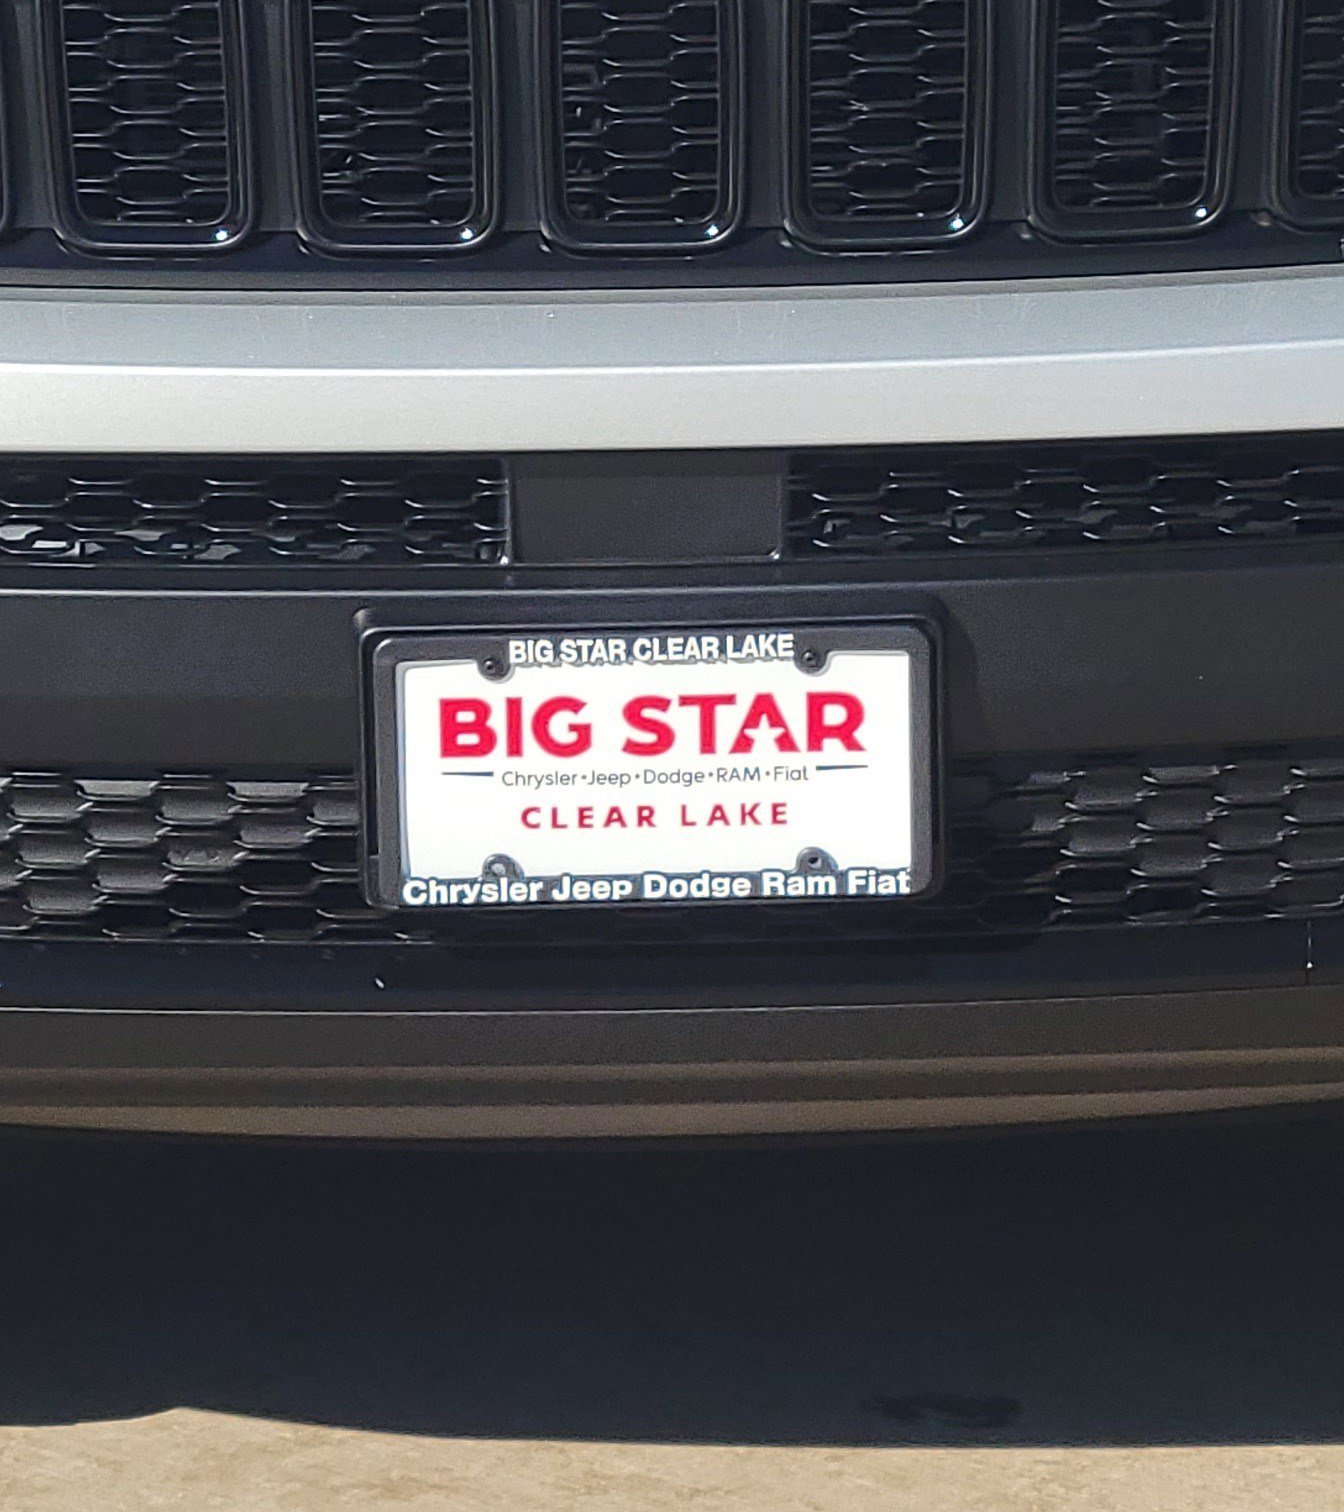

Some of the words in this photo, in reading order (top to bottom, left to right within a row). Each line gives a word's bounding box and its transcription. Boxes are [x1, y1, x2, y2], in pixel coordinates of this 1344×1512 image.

[509, 639, 553, 663] BIG
[559, 638, 626, 662] STAR
[633, 636, 719, 660] CLEAR
[726, 634, 794, 658] LAKE
[440, 696, 593, 758] BIG
[622, 692, 866, 755] STAR
[502, 770, 578, 789] Chrysler
[588, 769, 631, 788] Jeep
[643, 768, 705, 787] Dodge
[716, 767, 761, 782] RAM
[773, 766, 809, 781] Fiat
[521, 805, 656, 829] CLEAR
[681, 802, 788, 826] LAKE
[403, 876, 544, 905] Chrysler
[552, 874, 633, 901] Jeep
[643, 870, 750, 899] Dodge
[762, 870, 836, 896] Ram
[847, 869, 910, 895] Fiat
